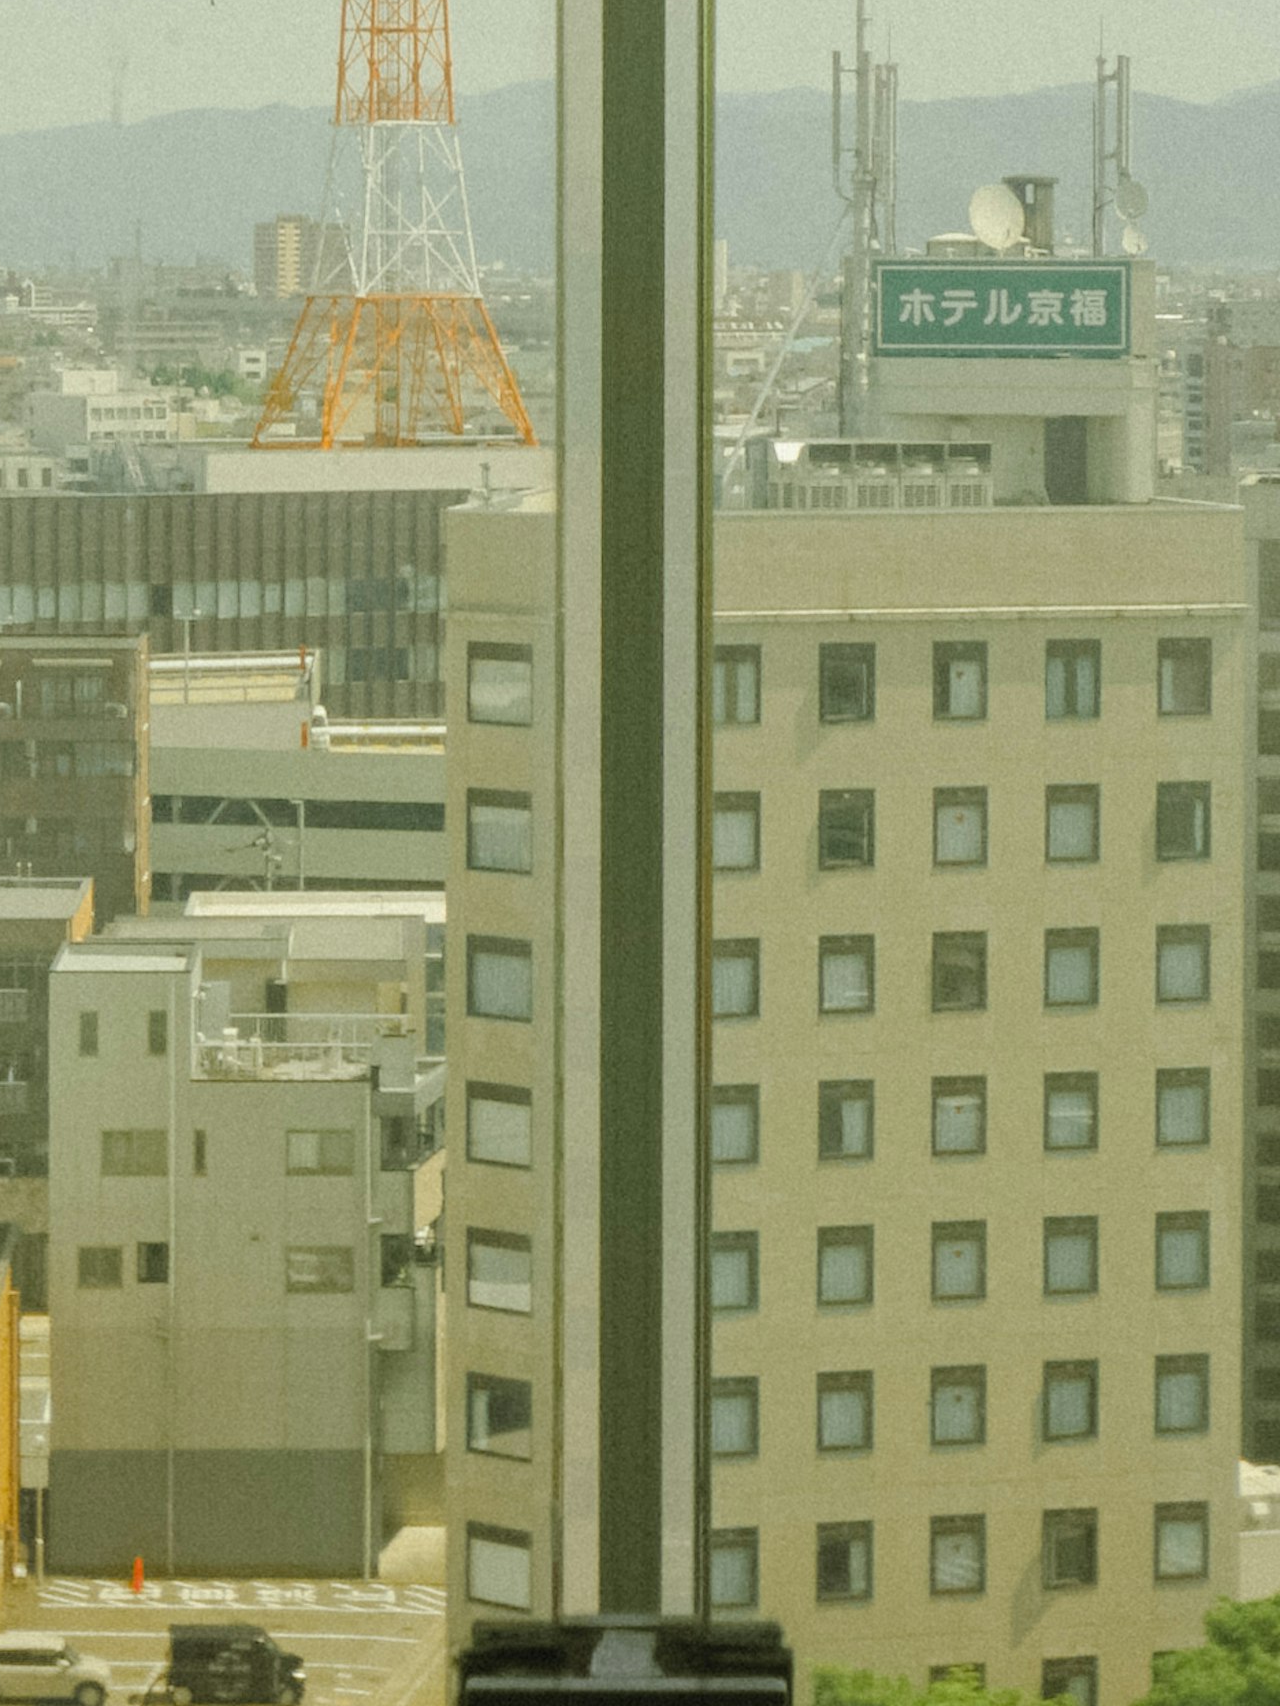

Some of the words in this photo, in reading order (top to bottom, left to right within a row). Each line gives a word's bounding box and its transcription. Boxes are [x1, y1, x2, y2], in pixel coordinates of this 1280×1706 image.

[898, 288, 1108, 327] ホテル京福
